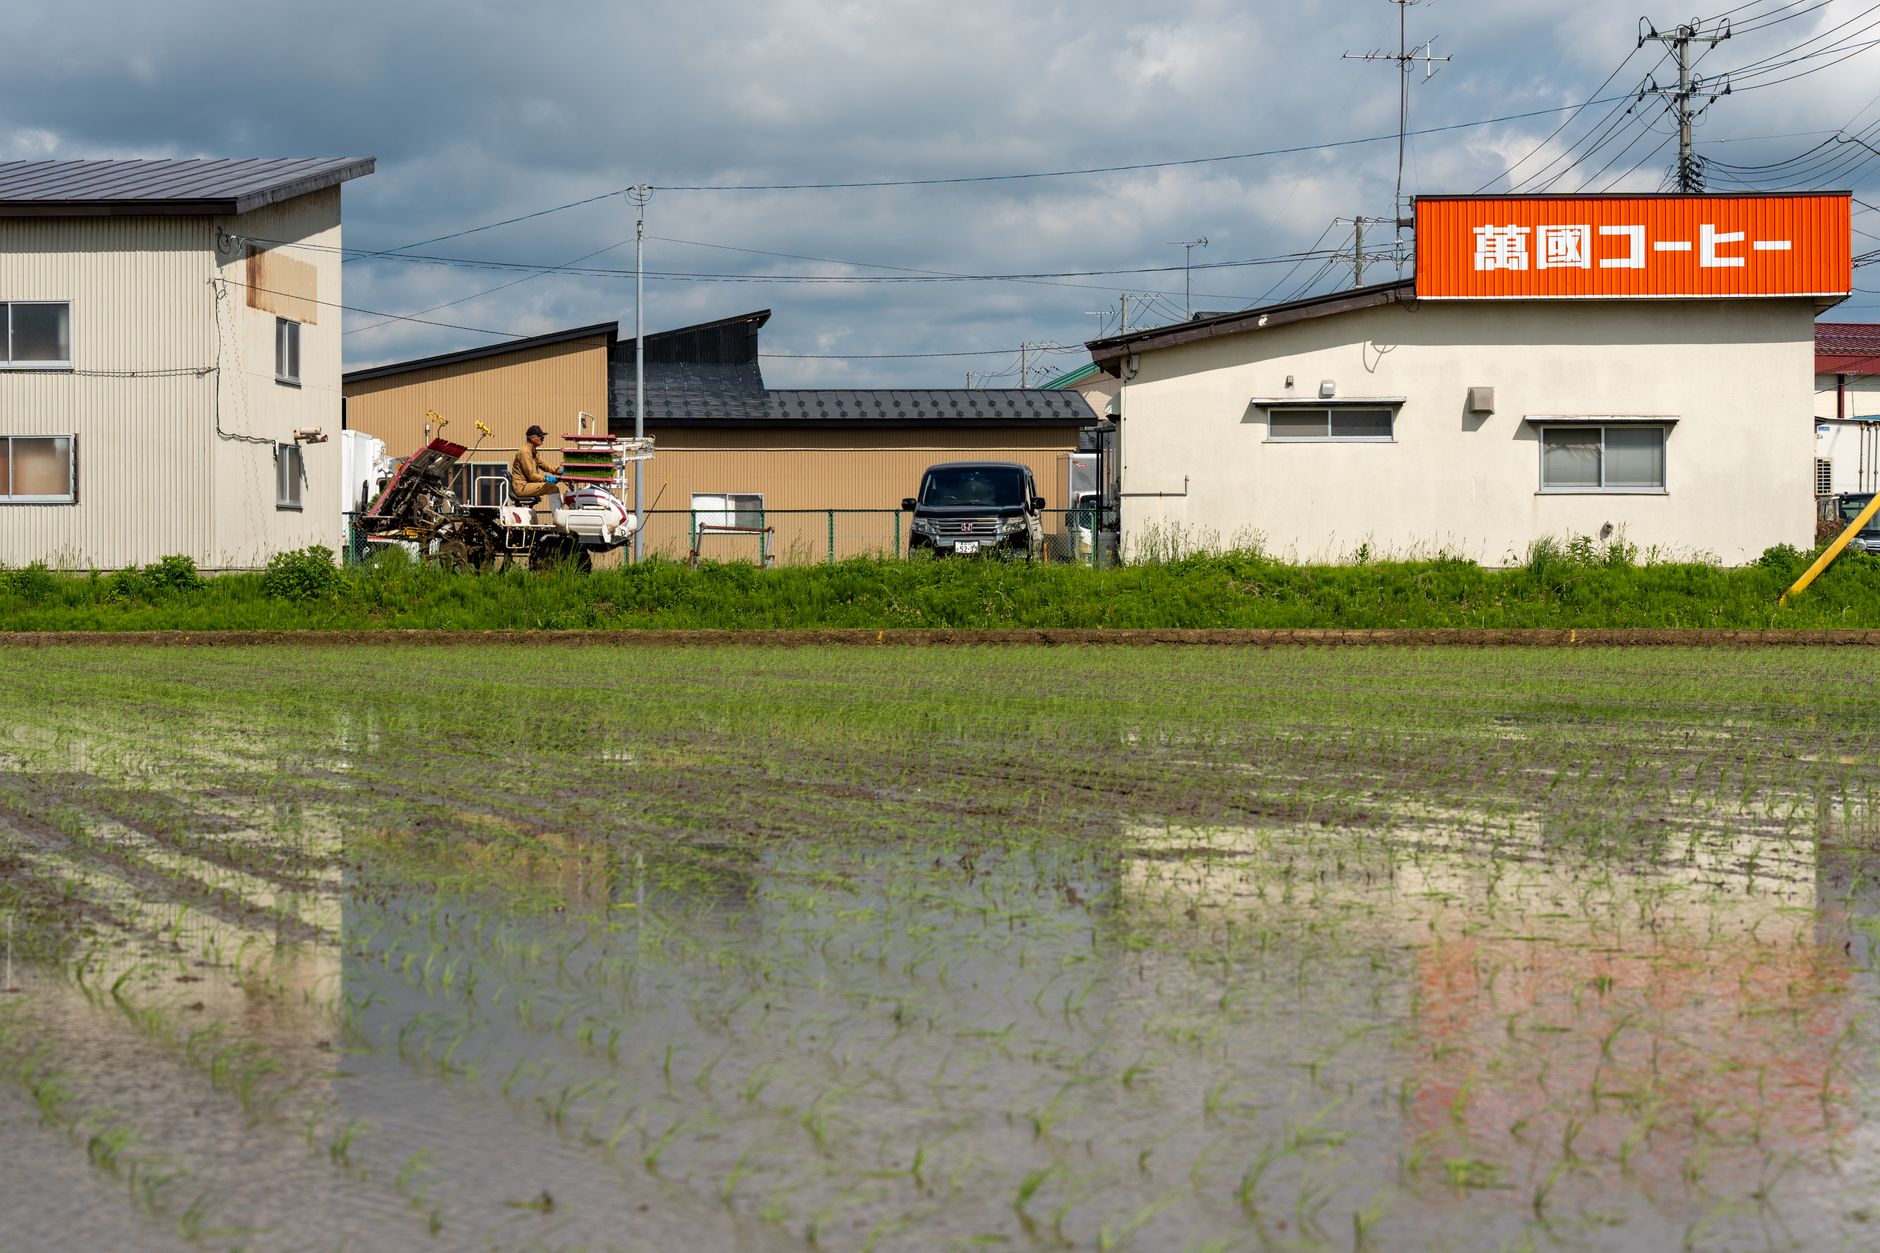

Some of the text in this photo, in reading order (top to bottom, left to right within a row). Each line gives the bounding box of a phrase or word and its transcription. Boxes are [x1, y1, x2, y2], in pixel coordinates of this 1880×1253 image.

[1473, 223, 1792, 271] 萬國コーヒー
